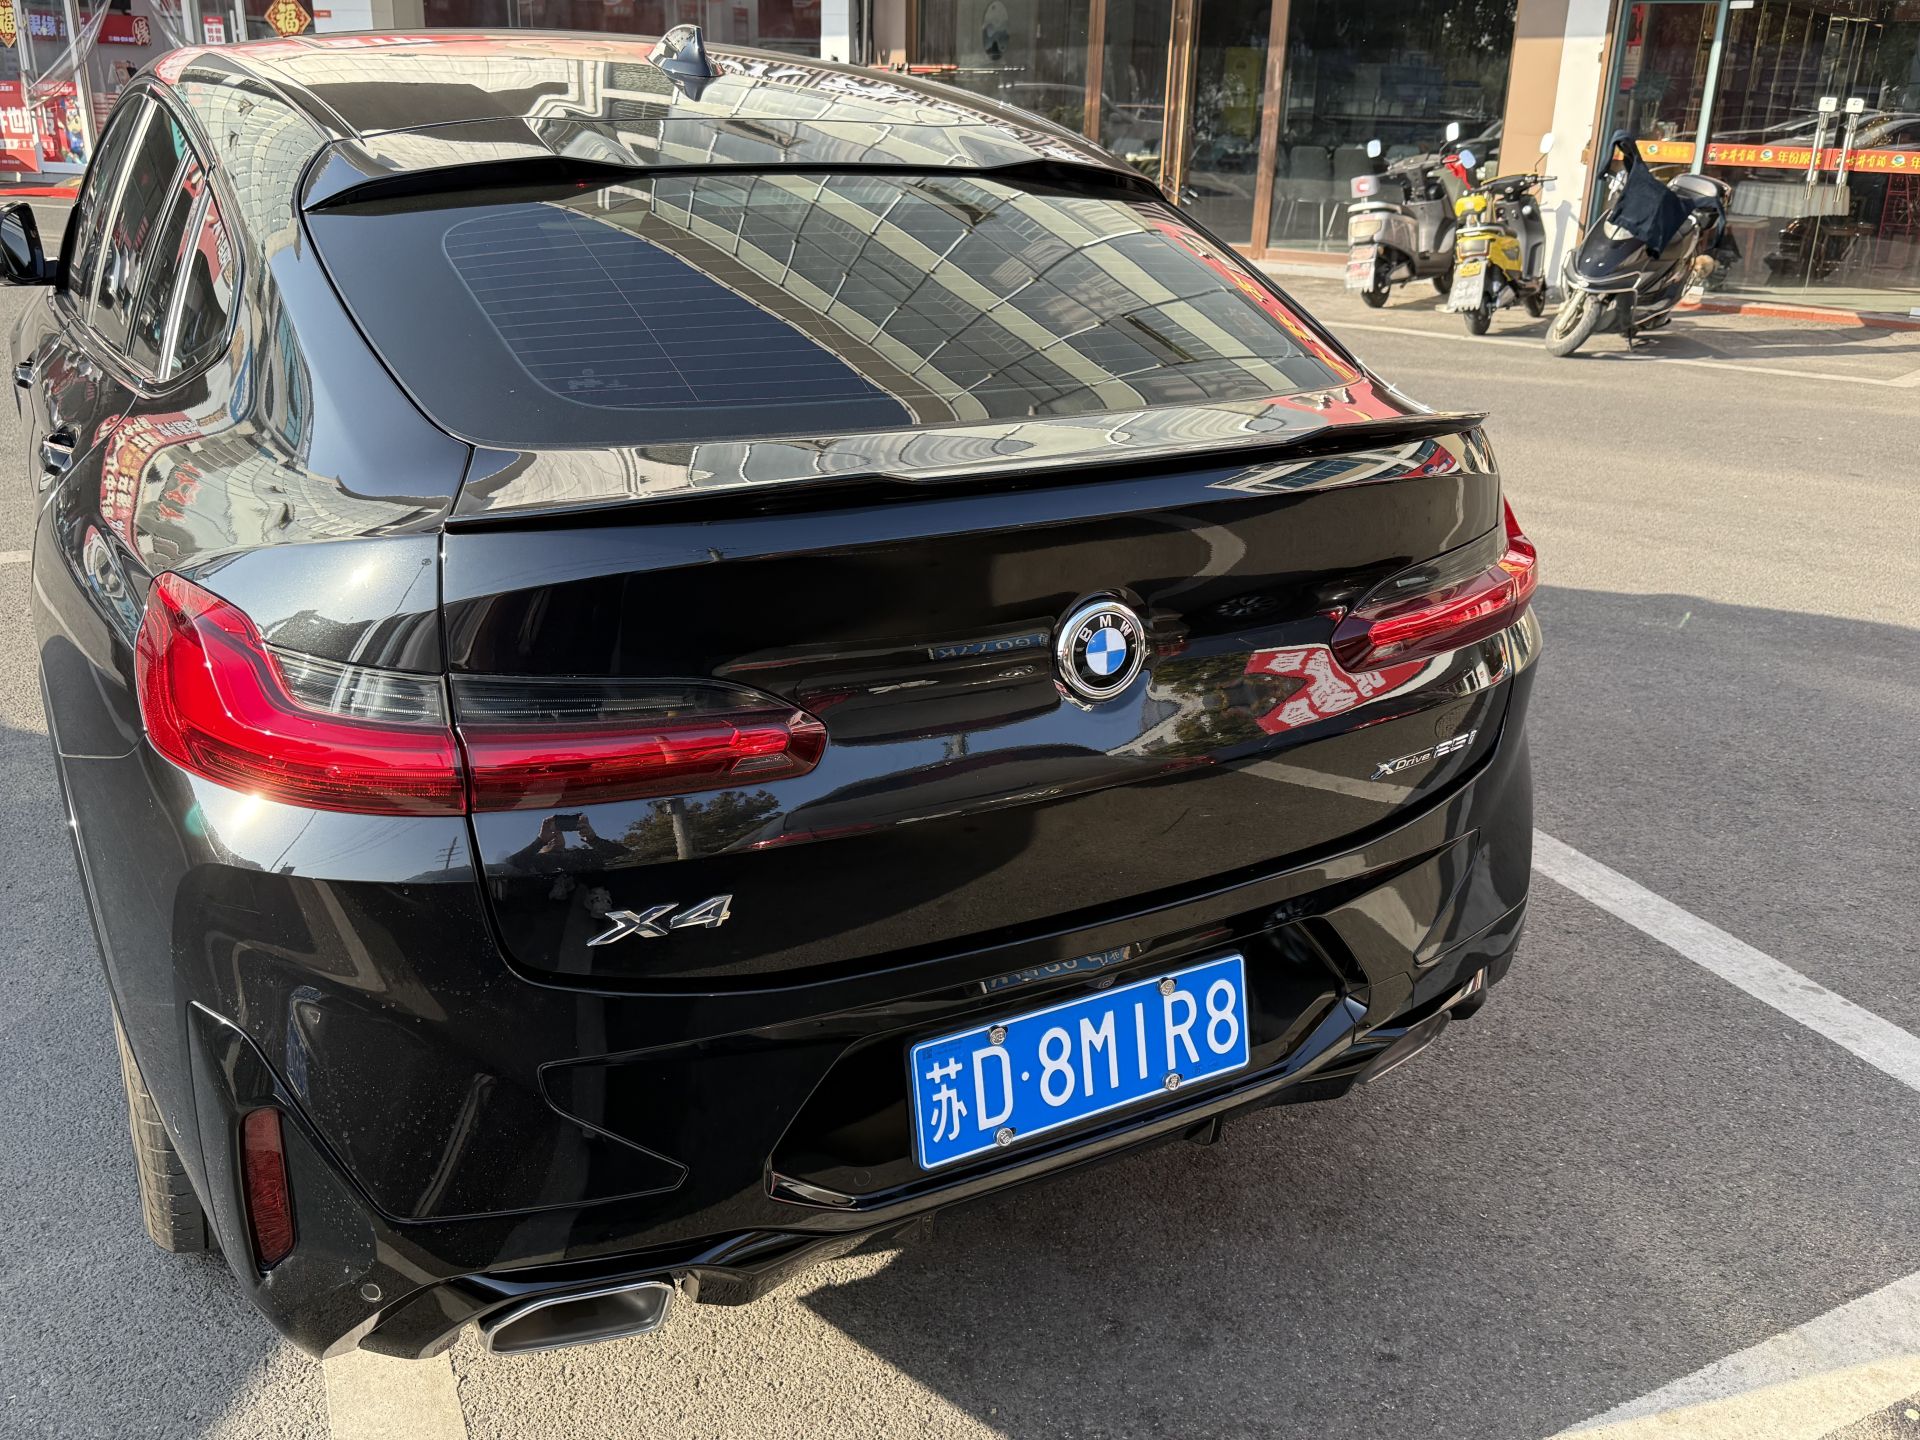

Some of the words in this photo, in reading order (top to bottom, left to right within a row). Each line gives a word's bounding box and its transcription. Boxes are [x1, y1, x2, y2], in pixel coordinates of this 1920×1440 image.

[276, 3, 299, 32] 福
[1079, 615, 1132, 642] BMW
[587, 894, 733, 947] X4
